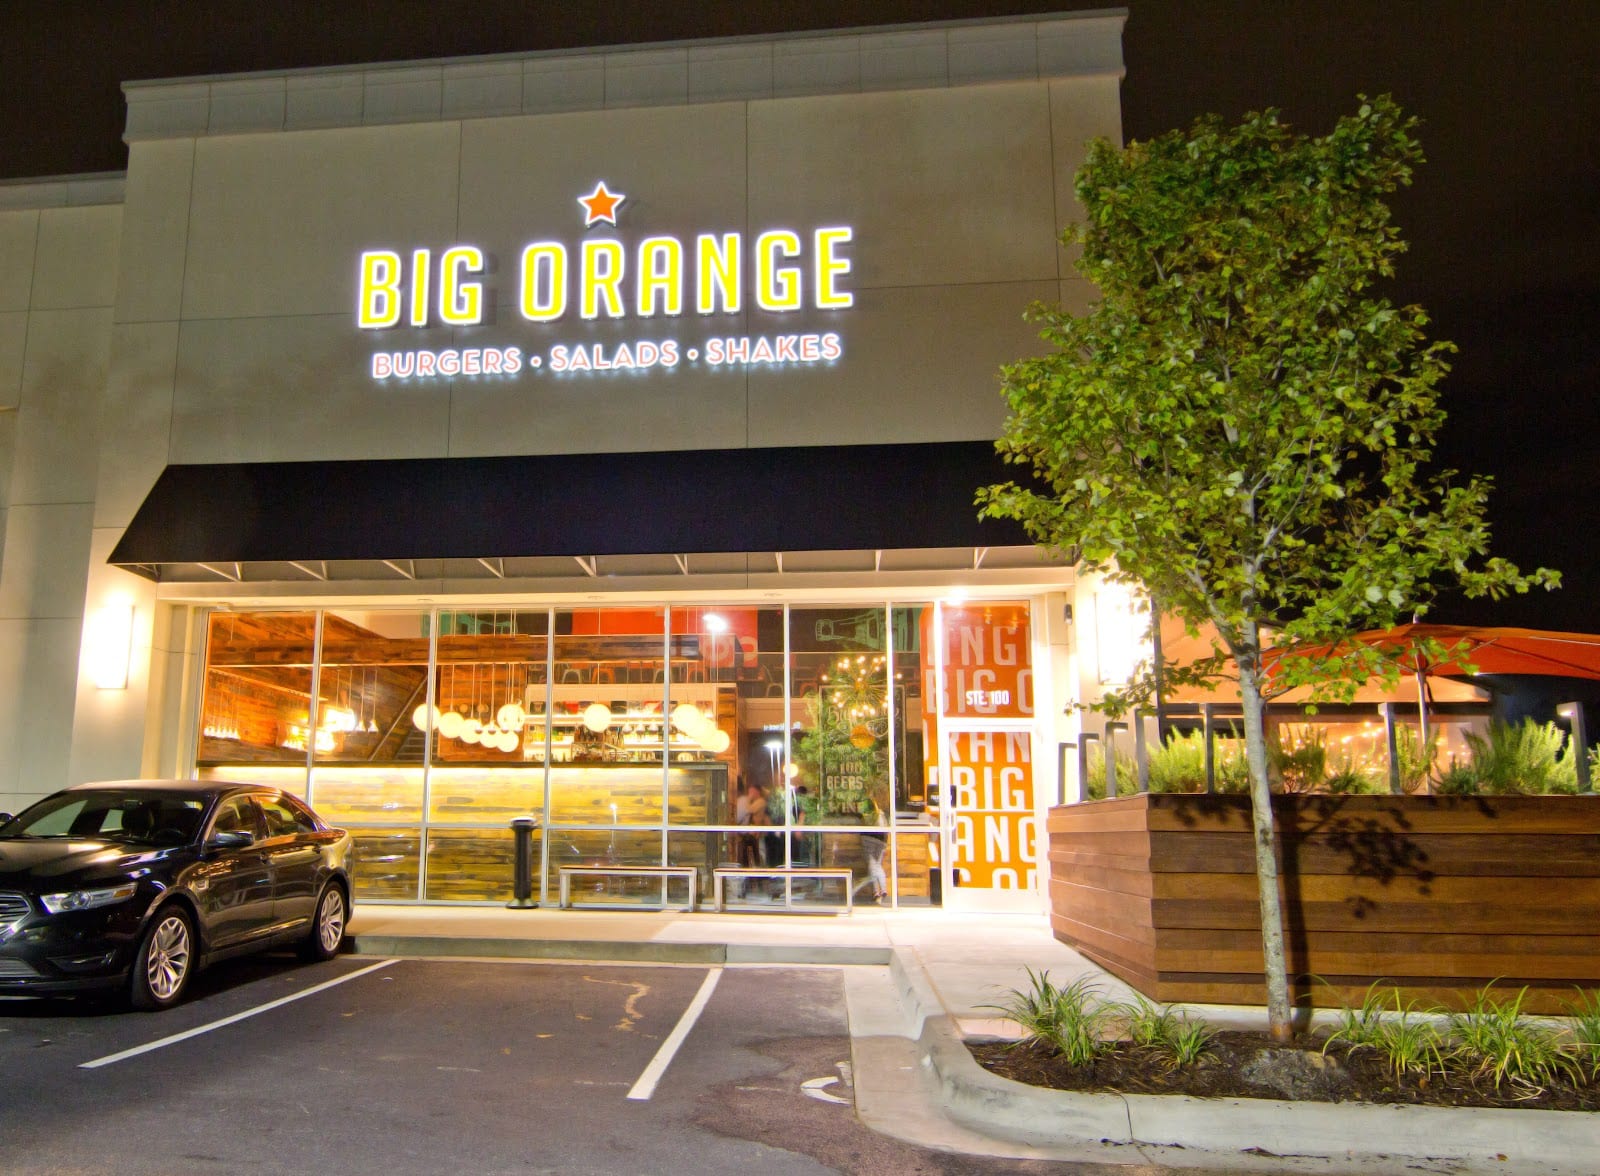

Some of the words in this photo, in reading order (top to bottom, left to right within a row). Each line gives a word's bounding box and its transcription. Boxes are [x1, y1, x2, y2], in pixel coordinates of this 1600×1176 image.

[357, 245, 484, 329] BIG
[519, 227, 853, 321] ORANGE
[372, 347, 522, 379] BURGERS
[550, 342, 680, 371] SALADS
[705, 332, 842, 364] SHAKES
[925, 669, 997, 714] BIG
[990, 690, 1010, 705] 100
[951, 766, 1026, 810] BIG
